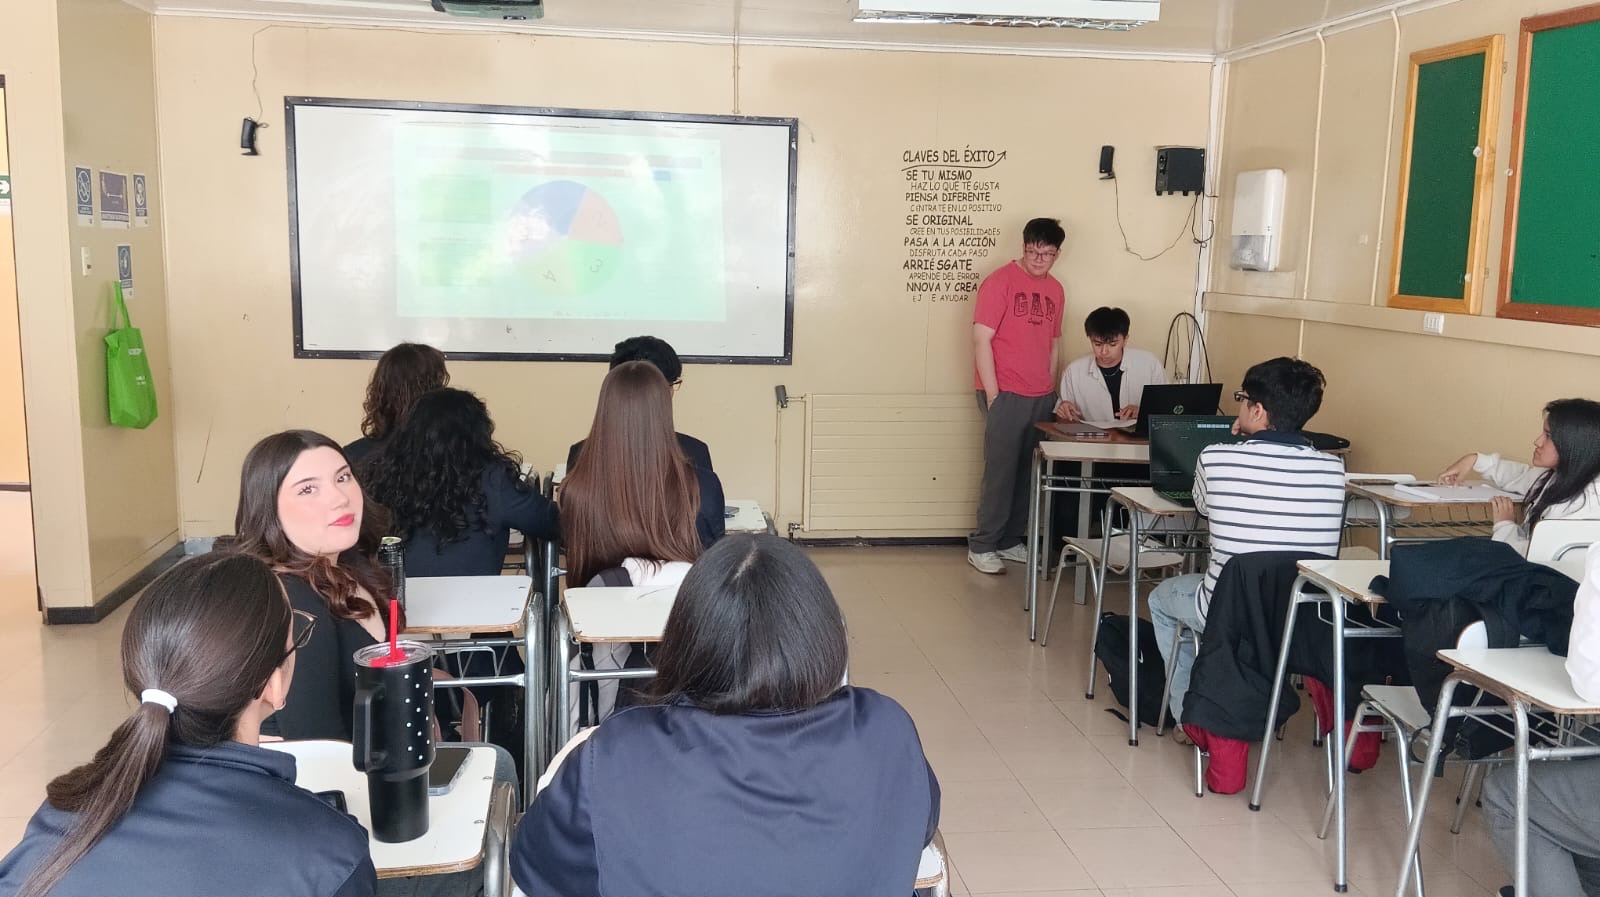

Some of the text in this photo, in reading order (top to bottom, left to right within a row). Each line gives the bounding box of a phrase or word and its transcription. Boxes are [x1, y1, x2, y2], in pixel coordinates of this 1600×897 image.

[903, 144, 995, 162] CLAVES DEL ÉXITO
[906, 170, 972, 181] SE TU MISMO
[911, 181, 1000, 192] HAZ LO QUE TE GUSTA
[905, 192, 990, 202] PIENSA DIFERENTE
[968, 204, 1002, 212] POSITIVO
[906, 214, 973, 226] SE ORIGINAL
[926, 228, 935, 236] EN
[937, 228, 950, 236] TUS
[951, 228, 1000, 236] POSIBILIDADES
[904, 236, 996, 247] PASA A LA ACCIÓN
[909, 249, 988, 257] DISFRUTA CADA PASO
[909, 272, 980, 280] APRENDE DEL ERROR
[944, 282, 951, 292] Y
[954, 282, 978, 292] CREA
[940, 294, 969, 302] AYUDAR
[1013, 292, 1056, 322] GAP
